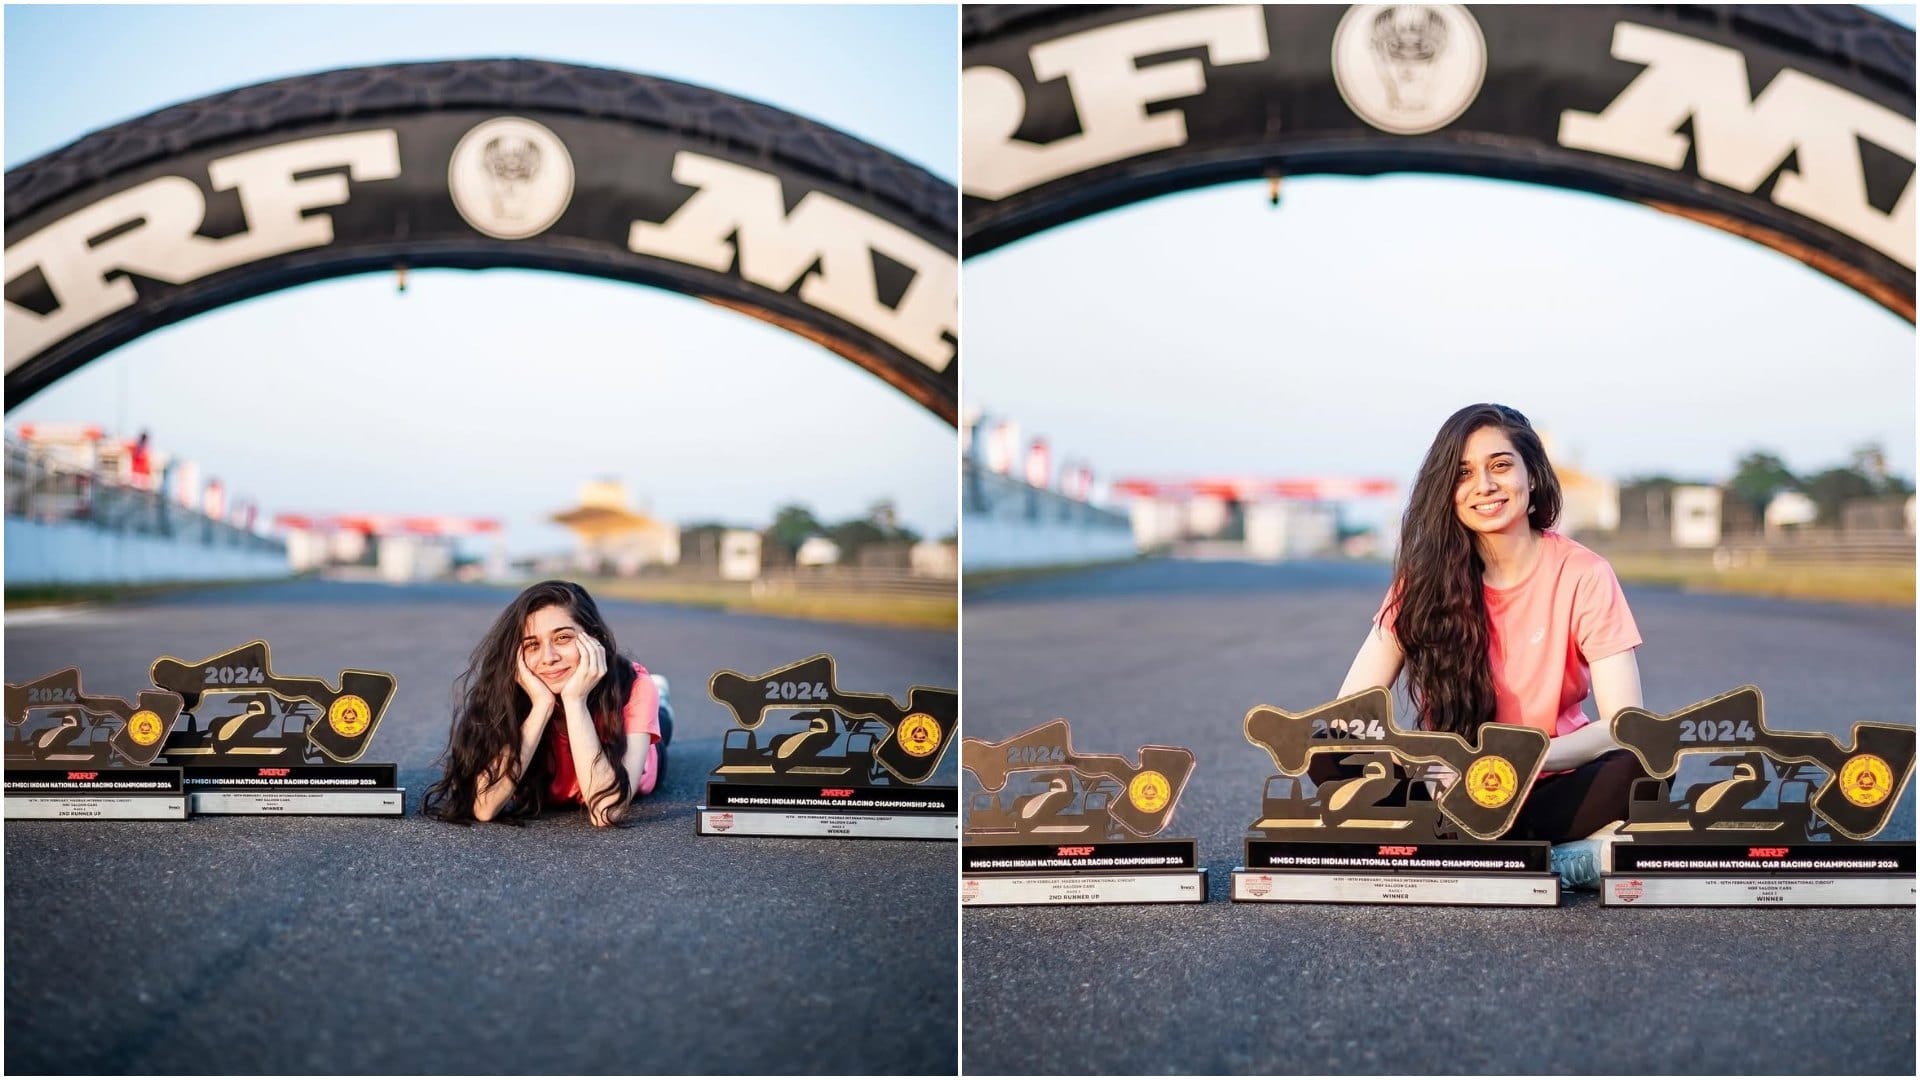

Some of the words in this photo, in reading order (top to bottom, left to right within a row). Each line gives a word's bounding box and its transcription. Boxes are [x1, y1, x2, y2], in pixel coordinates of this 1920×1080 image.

[204, 666, 265, 684] 2024
[29, 688, 77, 702] 2024
[765, 681, 829, 700] 2024
[1311, 718, 1385, 741] 2024
[1679, 719, 1756, 742] 2024
[1006, 745, 1066, 763] 2024
[67, 772, 98, 780] MRF
[258, 768, 290, 776] MRF
[820, 788, 854, 797] MRF
[1057, 846, 1095, 856] MRF
[1378, 846, 1418, 856] MRF
[1748, 848, 1788, 857] MRF
[1037, 859, 1072, 867] NATIONAL
[1072, 858, 1088, 866] CAR
[1087, 858, 1113, 866] RACING
[1114, 857, 1166, 865] CHAMPIONSHIP
[1269, 856, 1295, 865] MMSC
[1295, 857, 1320, 865] FMSCI
[1320, 857, 1349, 866] INDIAN
[1350, 858, 1391, 866] NATIONAL
[1409, 859, 1441, 867] RACING
[1441, 860, 1504, 868] CHAMPIONSHIP
[1636, 860, 1663, 868] MMSC
[1663, 860, 1689, 868] FMSCI
[1689, 860, 1718, 868] INDIAN
[1719, 860, 1761, 868] NATIONAL
[1761, 860, 1780, 868] CAR
[1780, 860, 1813, 868] RACING
[1813, 860, 1877, 868] CHAMPIONSHIP
[1877, 860, 1899, 868] 2024
